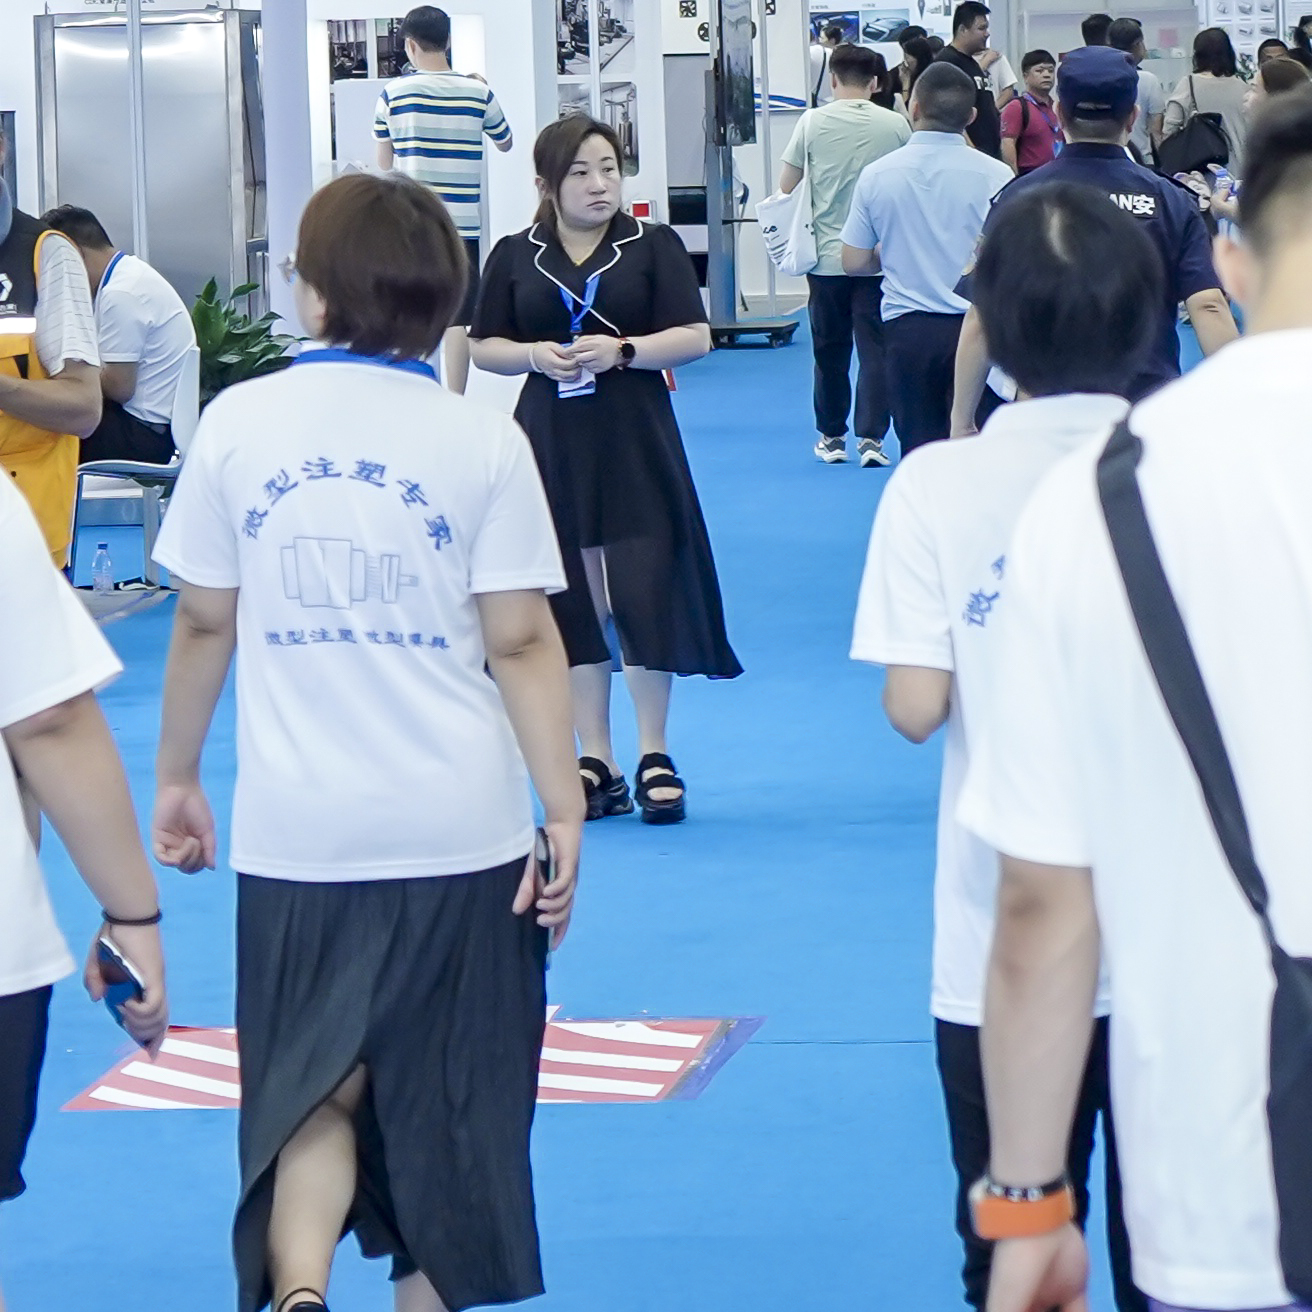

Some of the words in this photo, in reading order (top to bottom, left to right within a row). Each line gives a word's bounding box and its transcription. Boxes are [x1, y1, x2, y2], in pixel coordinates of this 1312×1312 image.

[242, 457, 453, 551] 微型注塑专家
